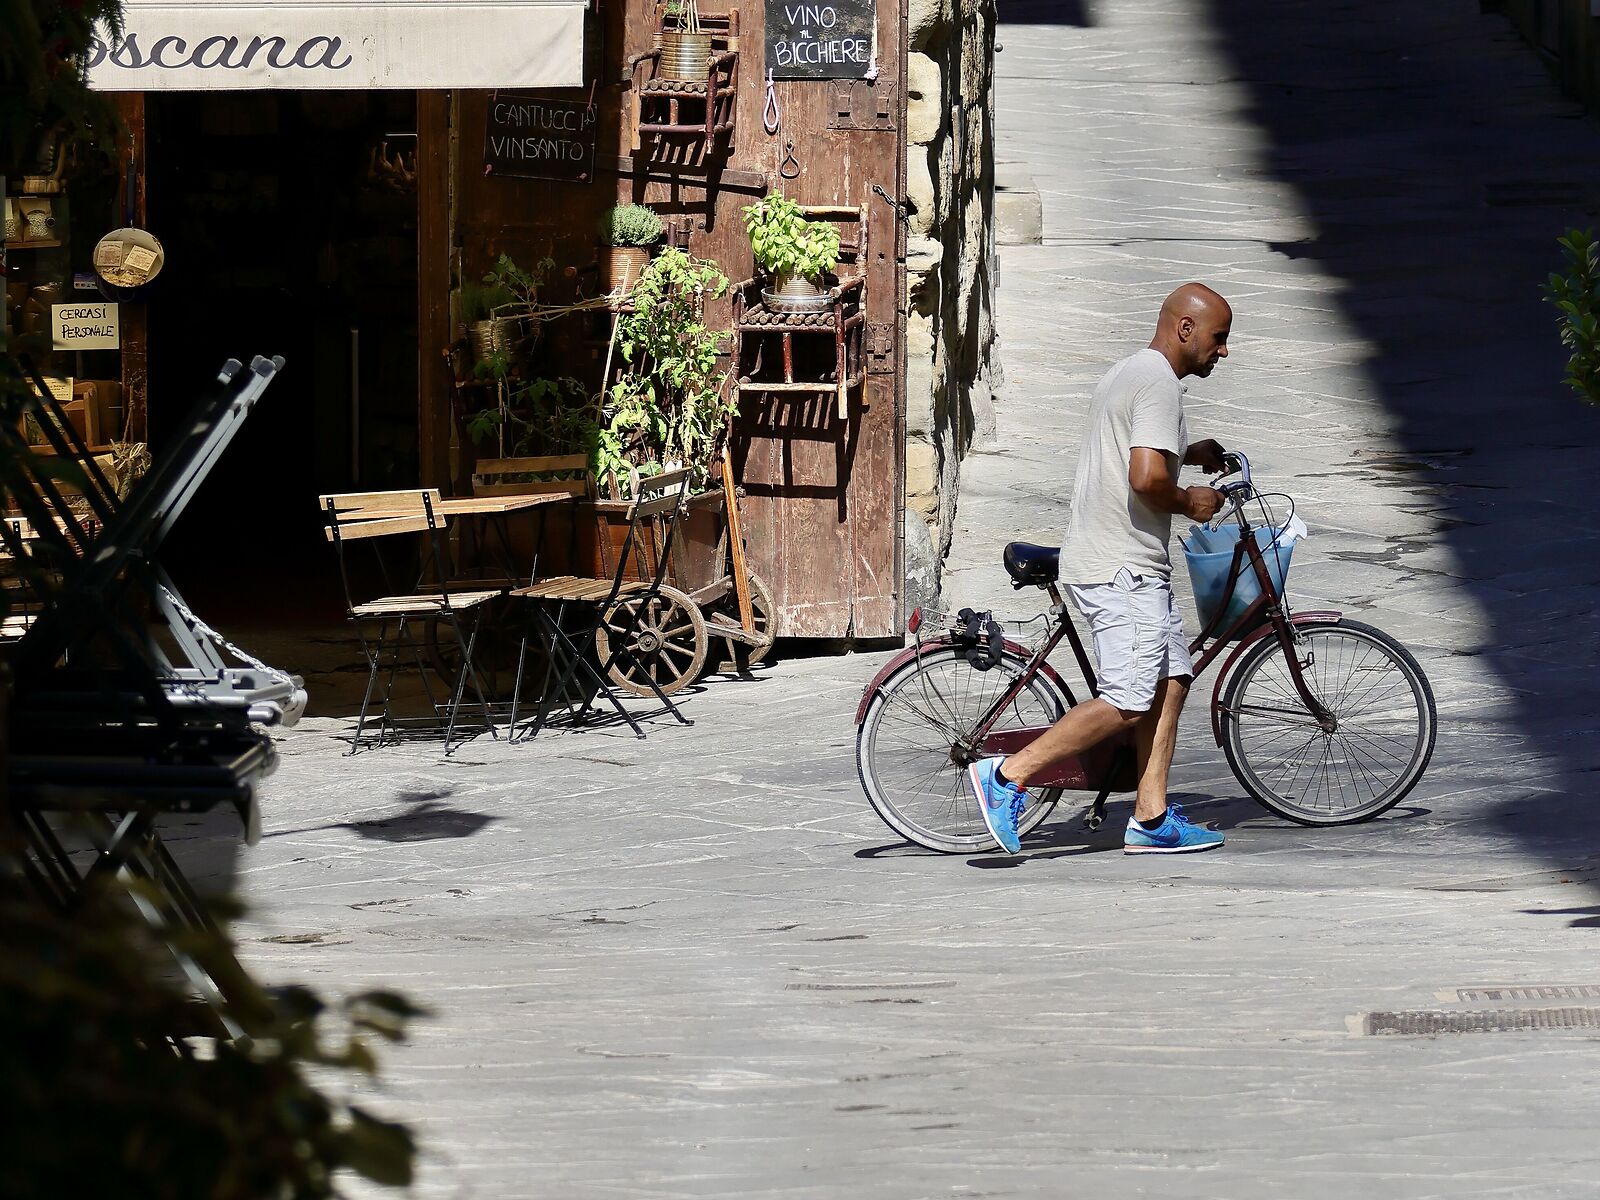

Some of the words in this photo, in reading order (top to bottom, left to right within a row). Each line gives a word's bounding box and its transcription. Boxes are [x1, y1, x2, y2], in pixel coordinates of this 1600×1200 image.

[785, 5, 836, 28] VINO
[775, 38, 868, 66] BICCHIERE
[494, 103, 584, 131] CANTUCCI
[491, 136, 584, 161] VINSANTO
[62, 324, 114, 340] PERSONALE
